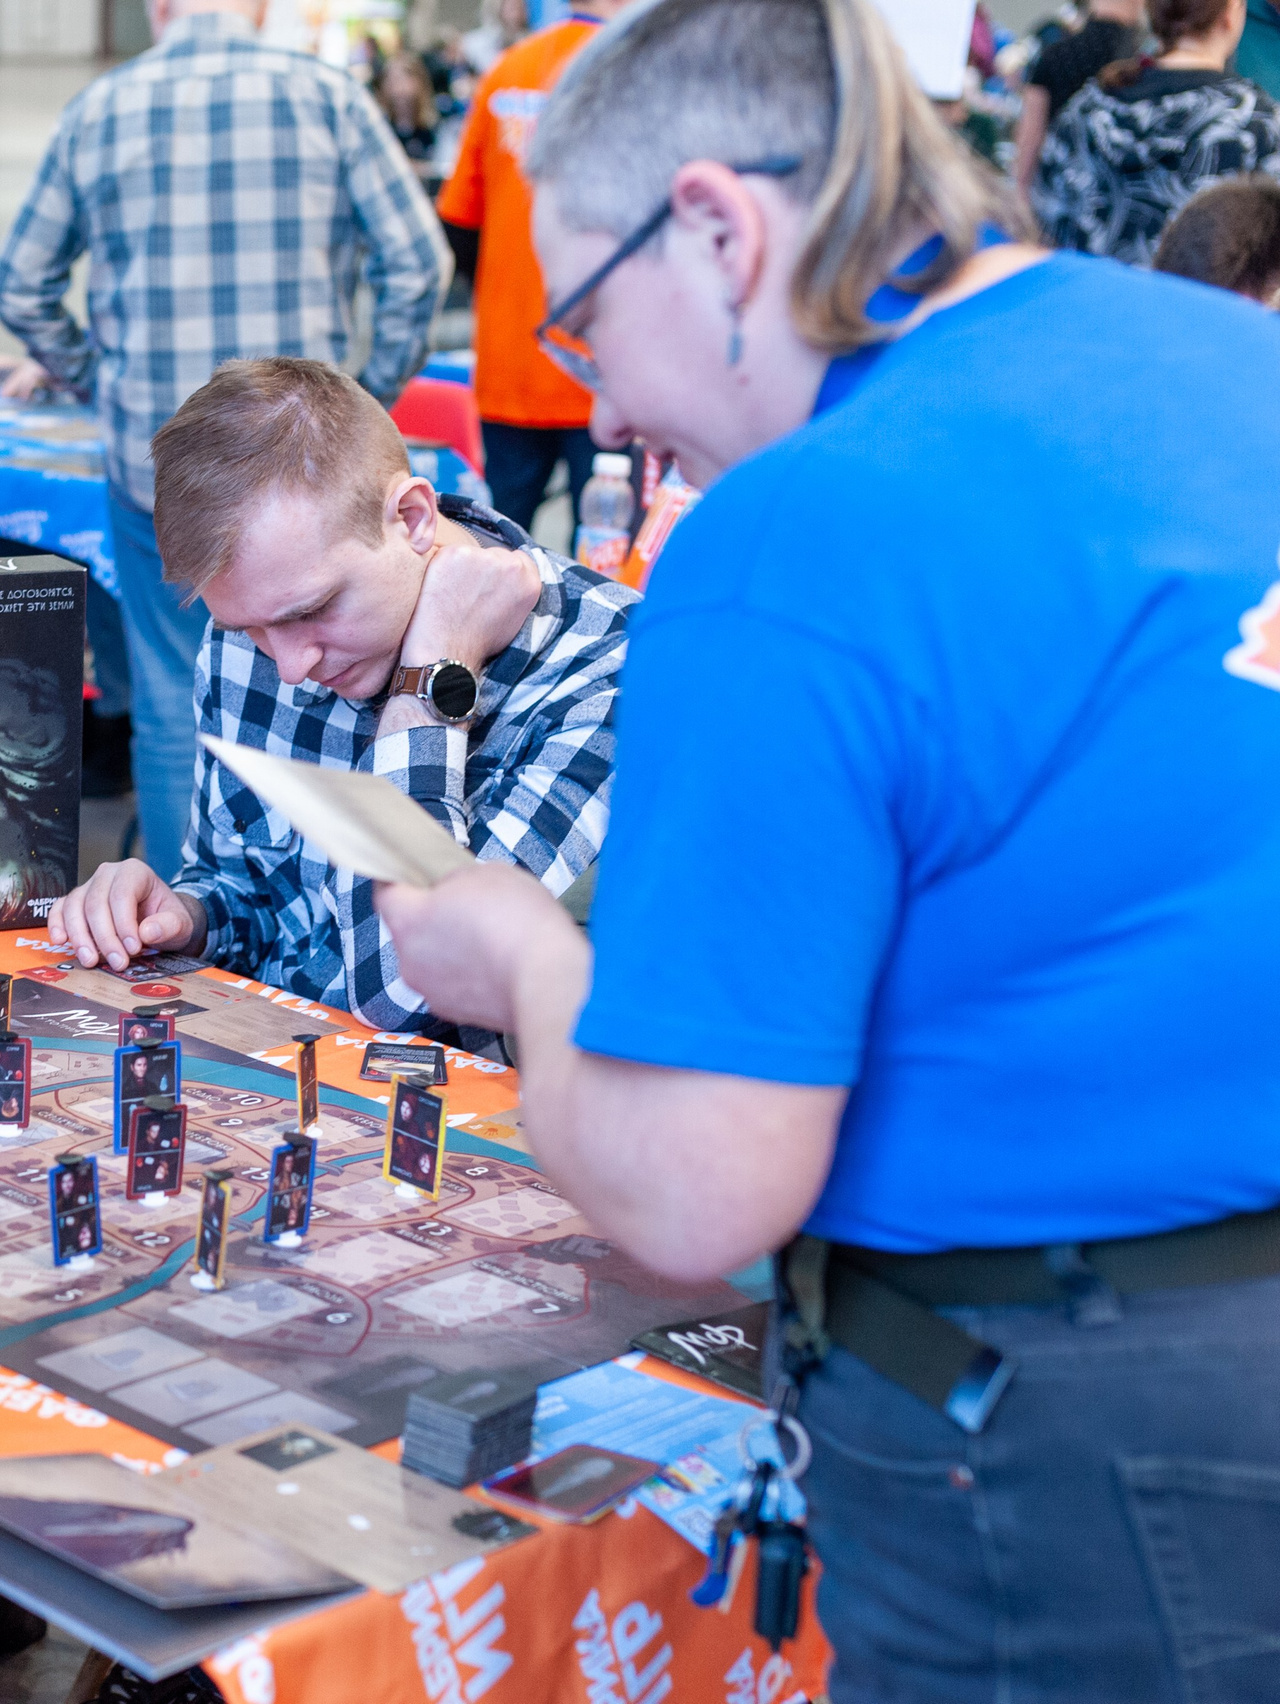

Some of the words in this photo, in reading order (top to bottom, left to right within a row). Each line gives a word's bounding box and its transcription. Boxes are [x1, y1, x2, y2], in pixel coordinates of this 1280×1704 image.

[27, 602, 45, 612] ЭТИ
[49, 601, 75, 611] ЗЕМЛИ
[27, 897, 60, 907] ФАБРИ
[33, 904, 52, 918] ИГ
[229, 1093, 262, 1106] 10
[220, 1118, 243, 1126] 9
[17, 1168, 49, 1182] 11
[241, 1167, 271, 1180] 15
[465, 1166, 489, 1176] 8
[417, 1221, 452, 1237] 13
[133, 1231, 171, 1247] 12
[54, 1288, 84, 1302] 5
[532, 1302, 561, 1314] 7
[326, 1312, 353, 1324] 6
